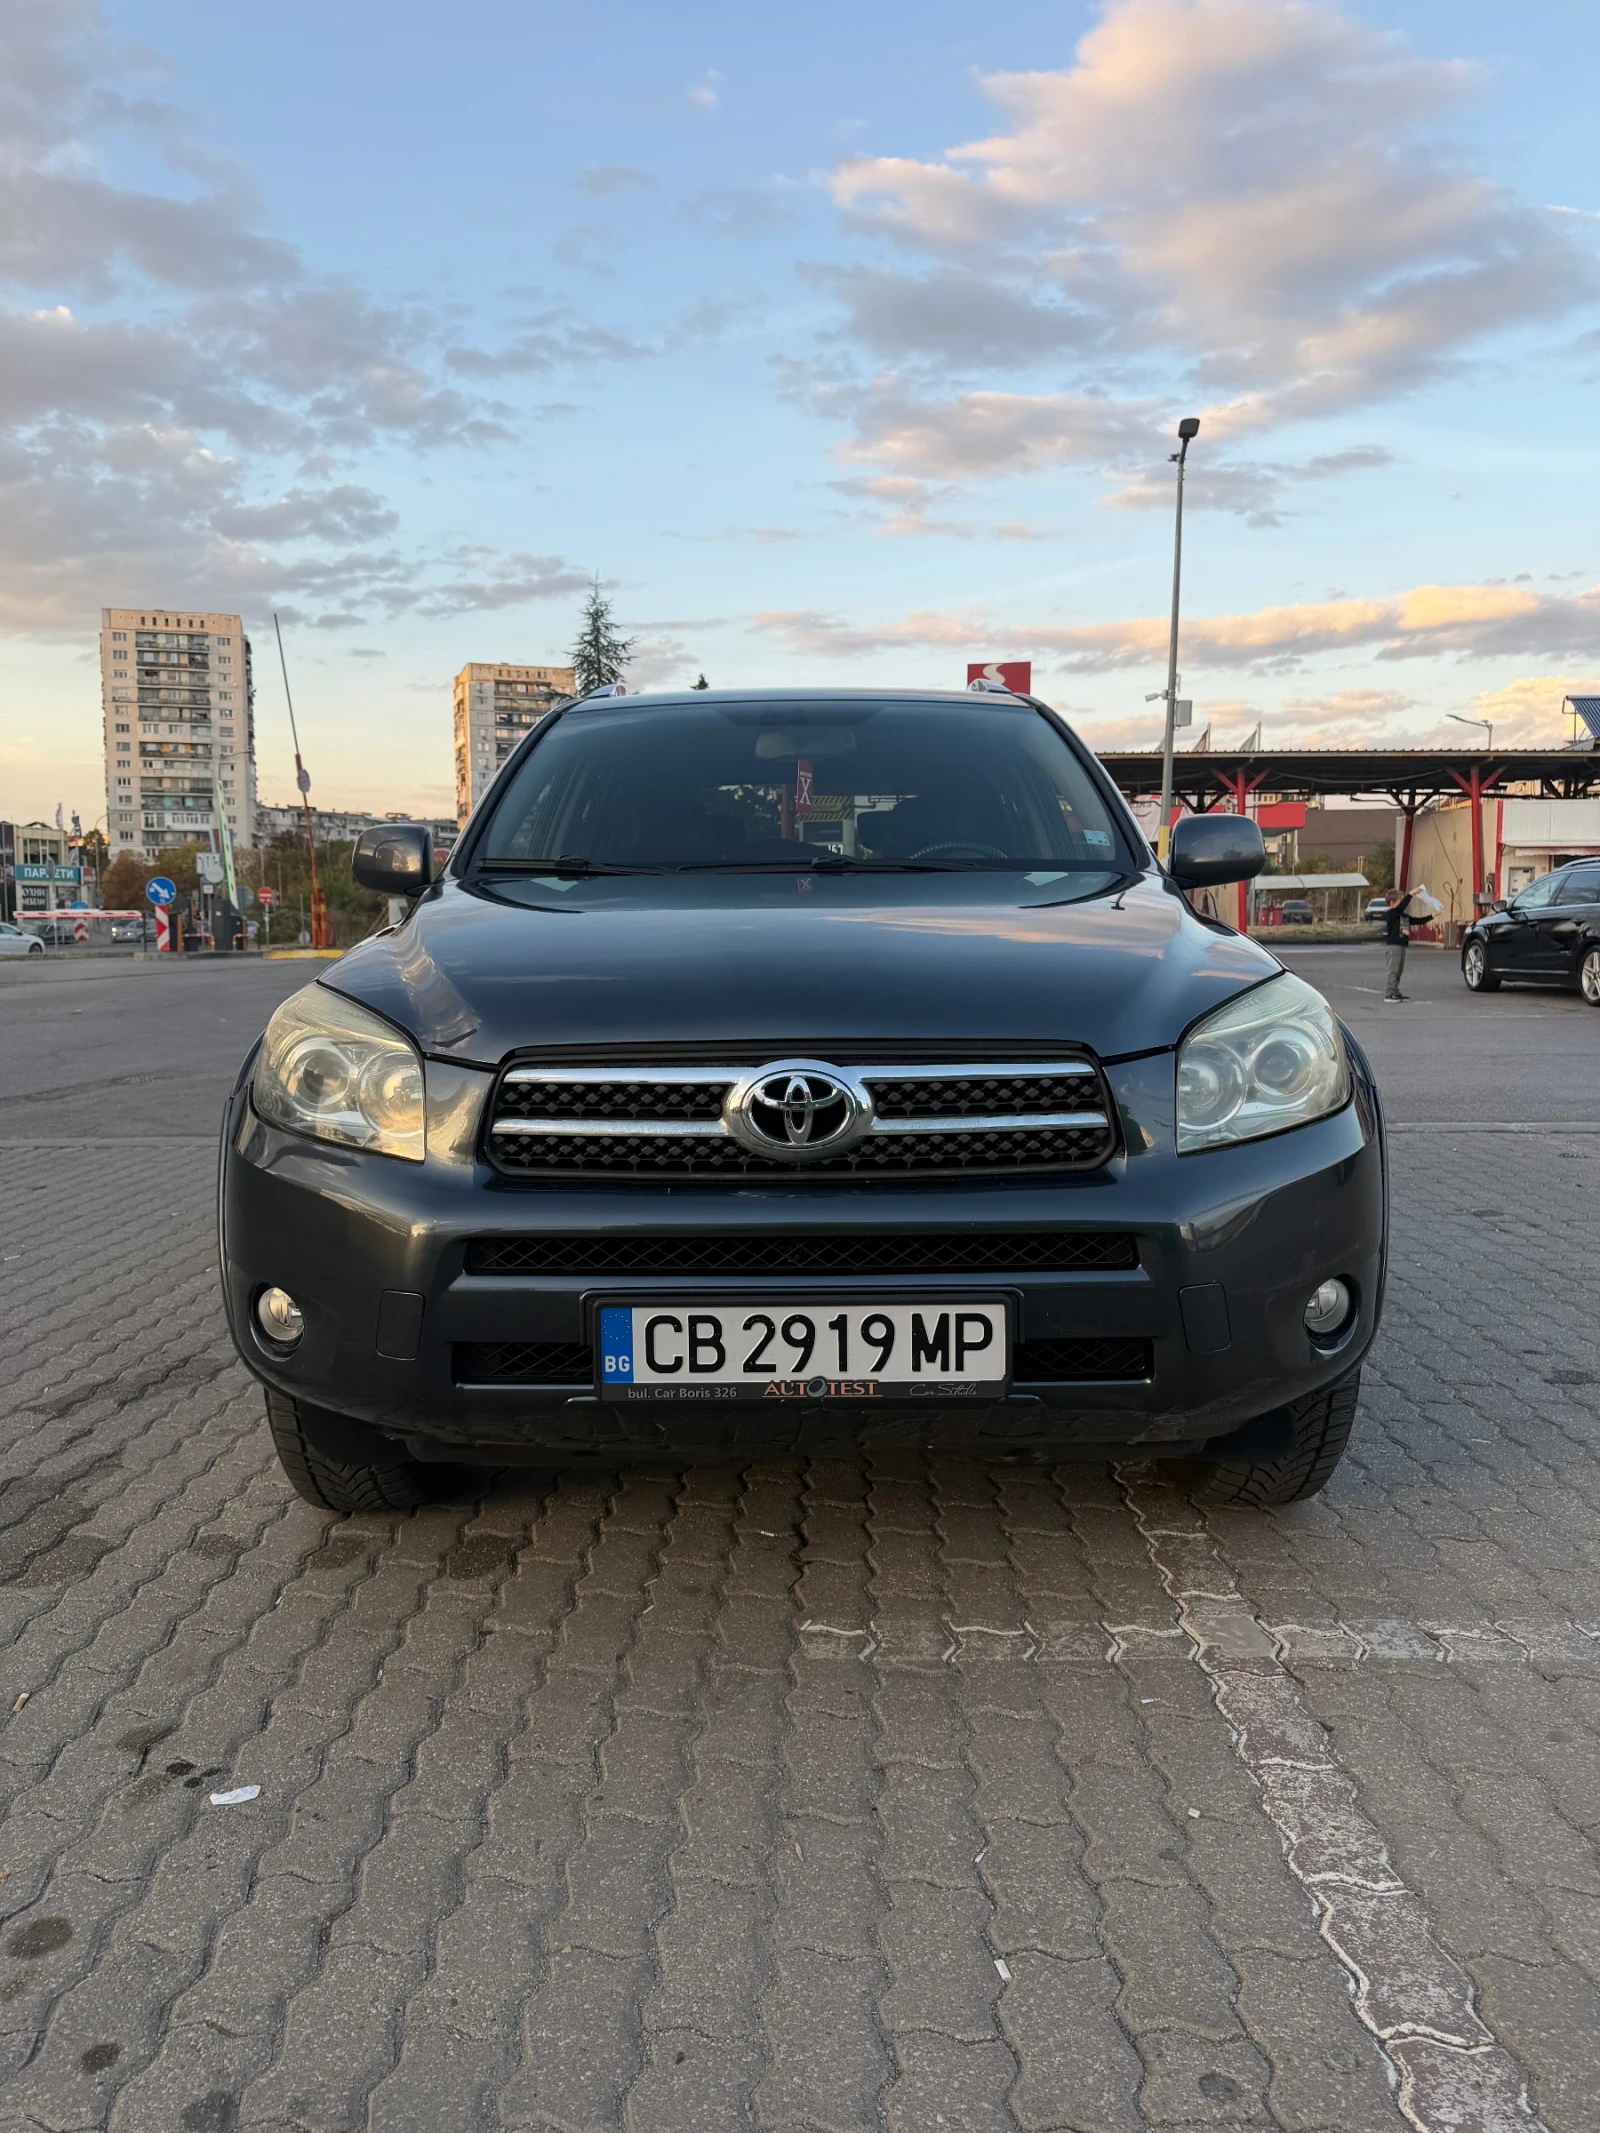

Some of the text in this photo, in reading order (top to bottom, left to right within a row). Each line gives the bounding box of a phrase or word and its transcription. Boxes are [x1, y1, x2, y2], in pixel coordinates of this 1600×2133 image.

[24, 867, 74, 879] ПАРЕТИ
[645, 1313, 993, 1373] CB 2919 MP
[604, 1355, 630, 1373] BG
[628, 1387, 737, 1399] bul. Car Boris 326
[764, 1378, 878, 1397] AUTOTEST
